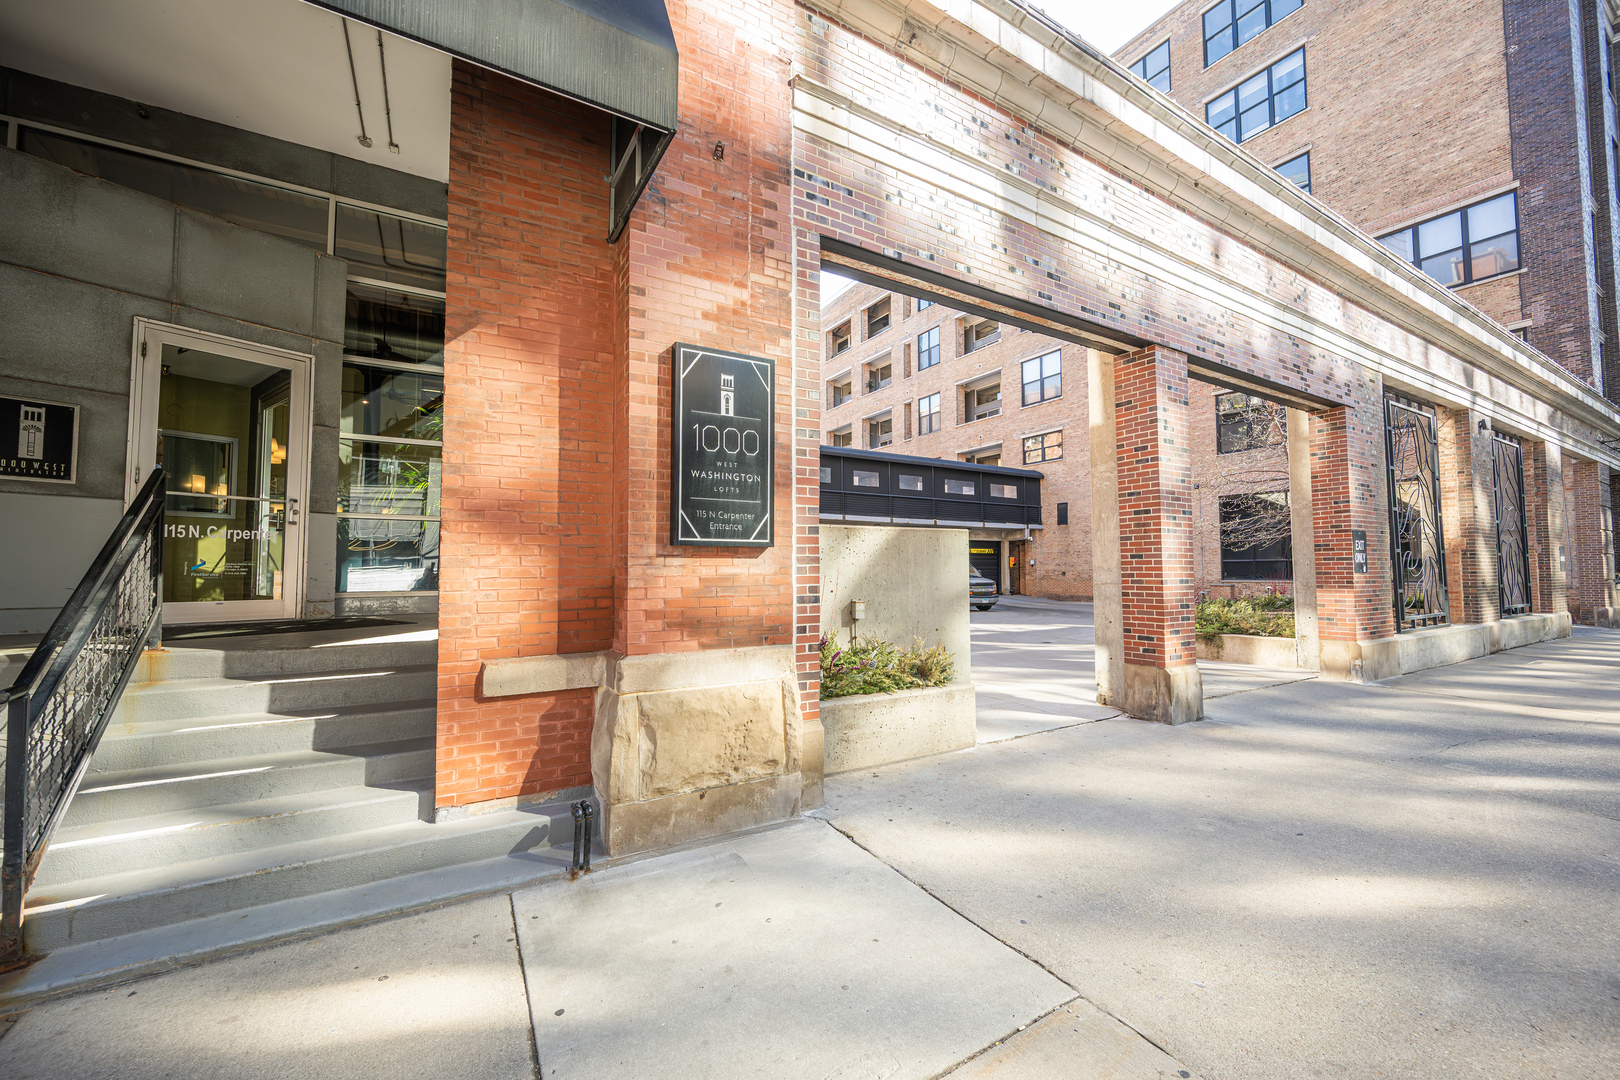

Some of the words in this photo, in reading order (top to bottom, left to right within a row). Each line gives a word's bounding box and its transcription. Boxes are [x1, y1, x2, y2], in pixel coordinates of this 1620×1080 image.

[692, 423, 760, 456] 1000
[0, 458, 26, 469] 000
[32, 461, 66, 471] WEST
[690, 469, 761, 482] WASHINGTON
[713, 486, 740, 494] LOFTS
[696, 509, 707, 518] 115
[708, 510, 716, 518] N
[717, 510, 755, 521] Carpenter
[709, 521, 743, 531] Entrance
[188, 524, 205, 539] N.
[206, 525, 279, 542] Carpenter
[1355, 540, 1365, 550] EXIT
[1355, 552, 1366, 563] ONLY
